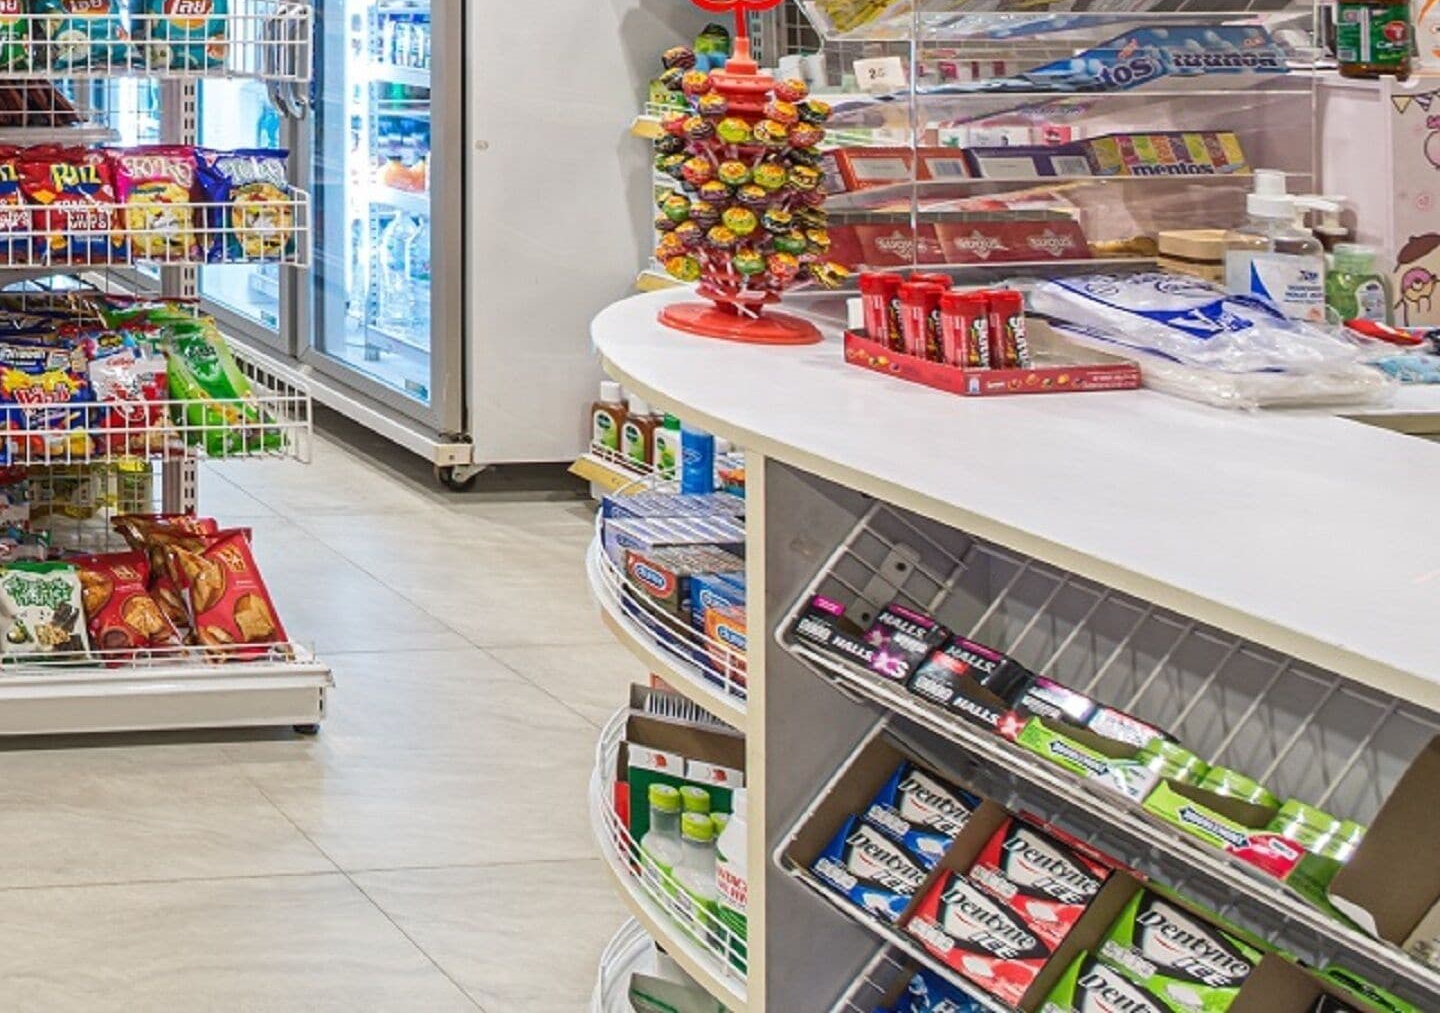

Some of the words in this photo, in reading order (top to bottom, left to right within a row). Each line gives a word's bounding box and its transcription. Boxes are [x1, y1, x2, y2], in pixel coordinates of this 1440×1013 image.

[1101, 57, 1153, 86] tos
[51, 163, 101, 191] RITZ
[1133, 161, 1215, 175] mentos
[877, 611, 927, 639] HALLS
[831, 634, 874, 663] HALLS
[945, 644, 997, 675] HALLS
[953, 695, 1002, 726] HALLS
[1003, 835, 1101, 896] Dentyne
[1033, 876, 1082, 905] ICE
[940, 887, 1037, 951] Dentyne
[968, 930, 1019, 961] ICE
[1135, 908, 1251, 978] Dentyne
[1172, 955, 1232, 988] ICE
